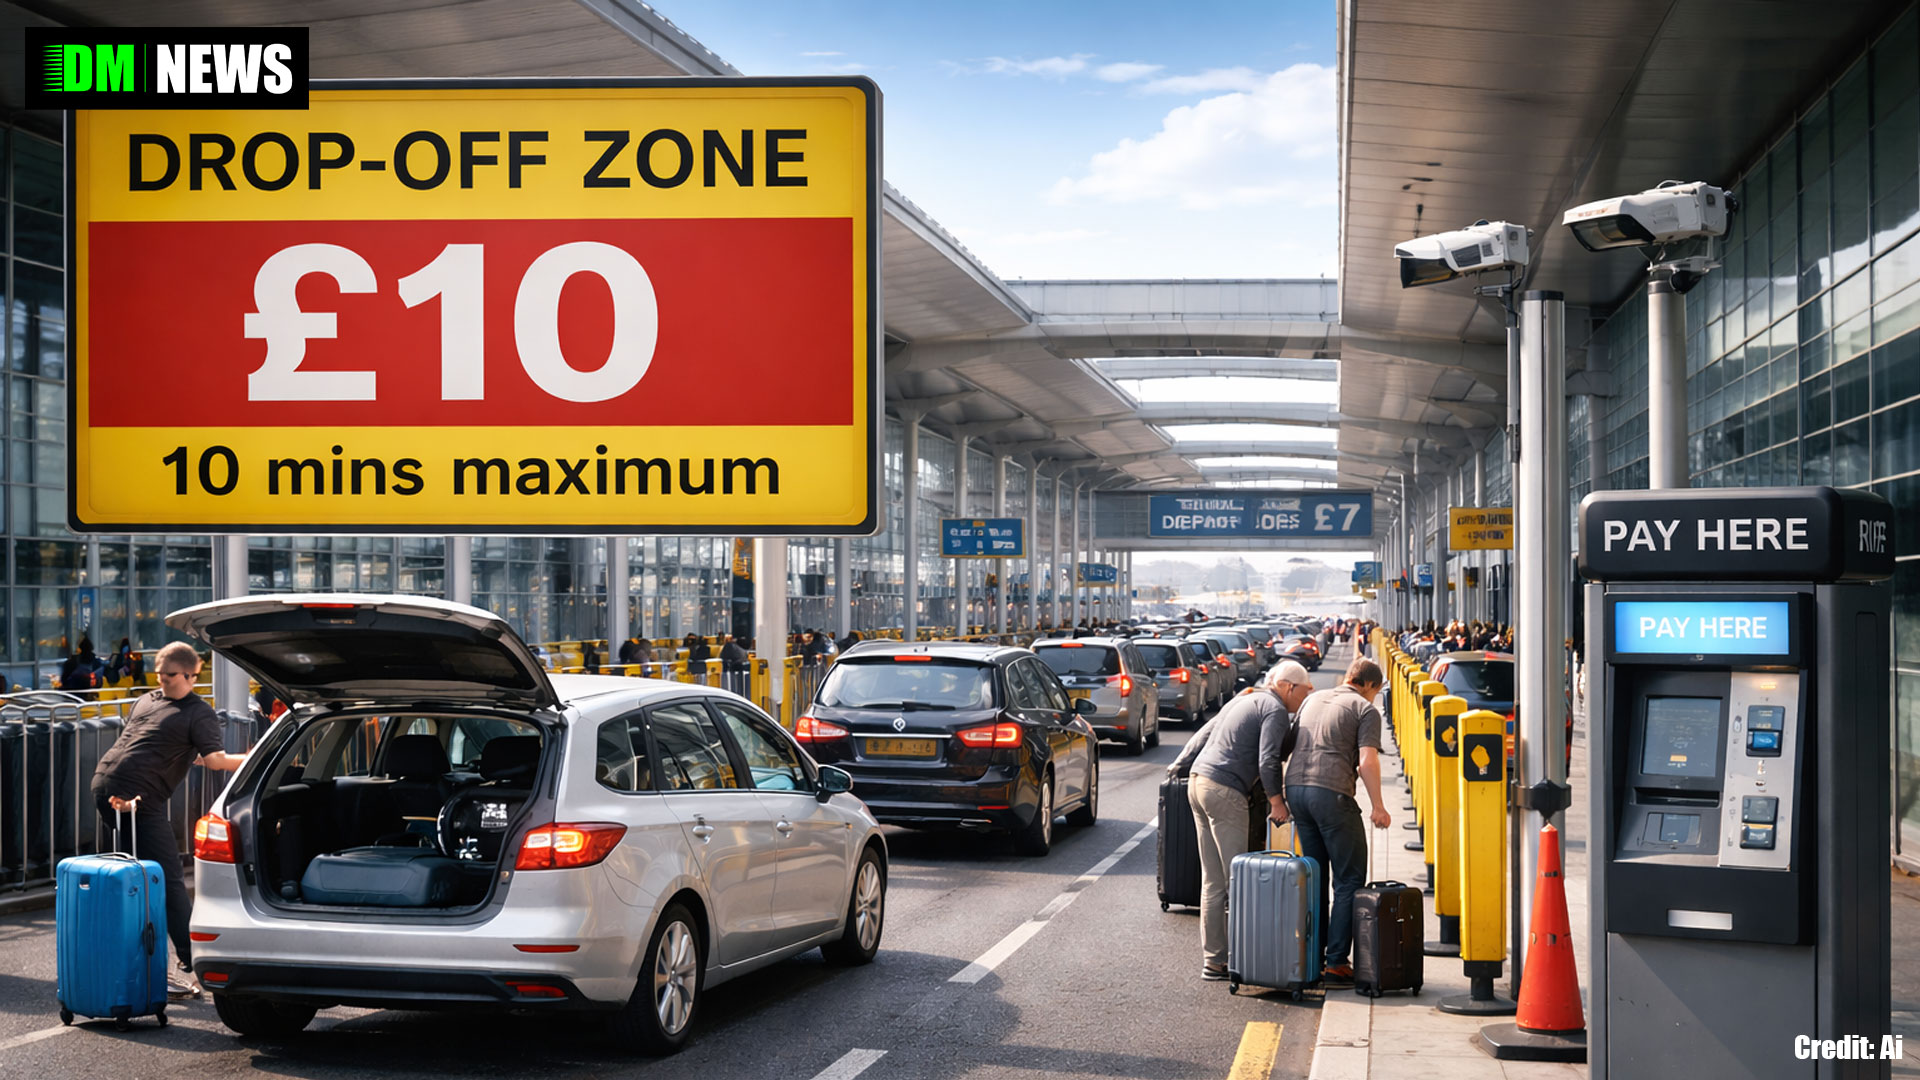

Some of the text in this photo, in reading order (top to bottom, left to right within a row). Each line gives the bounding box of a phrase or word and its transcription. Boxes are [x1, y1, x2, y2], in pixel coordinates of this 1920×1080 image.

[128, 128, 808, 192] DROP-OFF ZONE
[243, 241, 660, 403] £10
[162, 444, 780, 496] 10 mins maximum
[1314, 503, 1361, 531] £7
[1603, 517, 1809, 552] PAY HERE
[1639, 616, 1768, 639] PAY HERE
